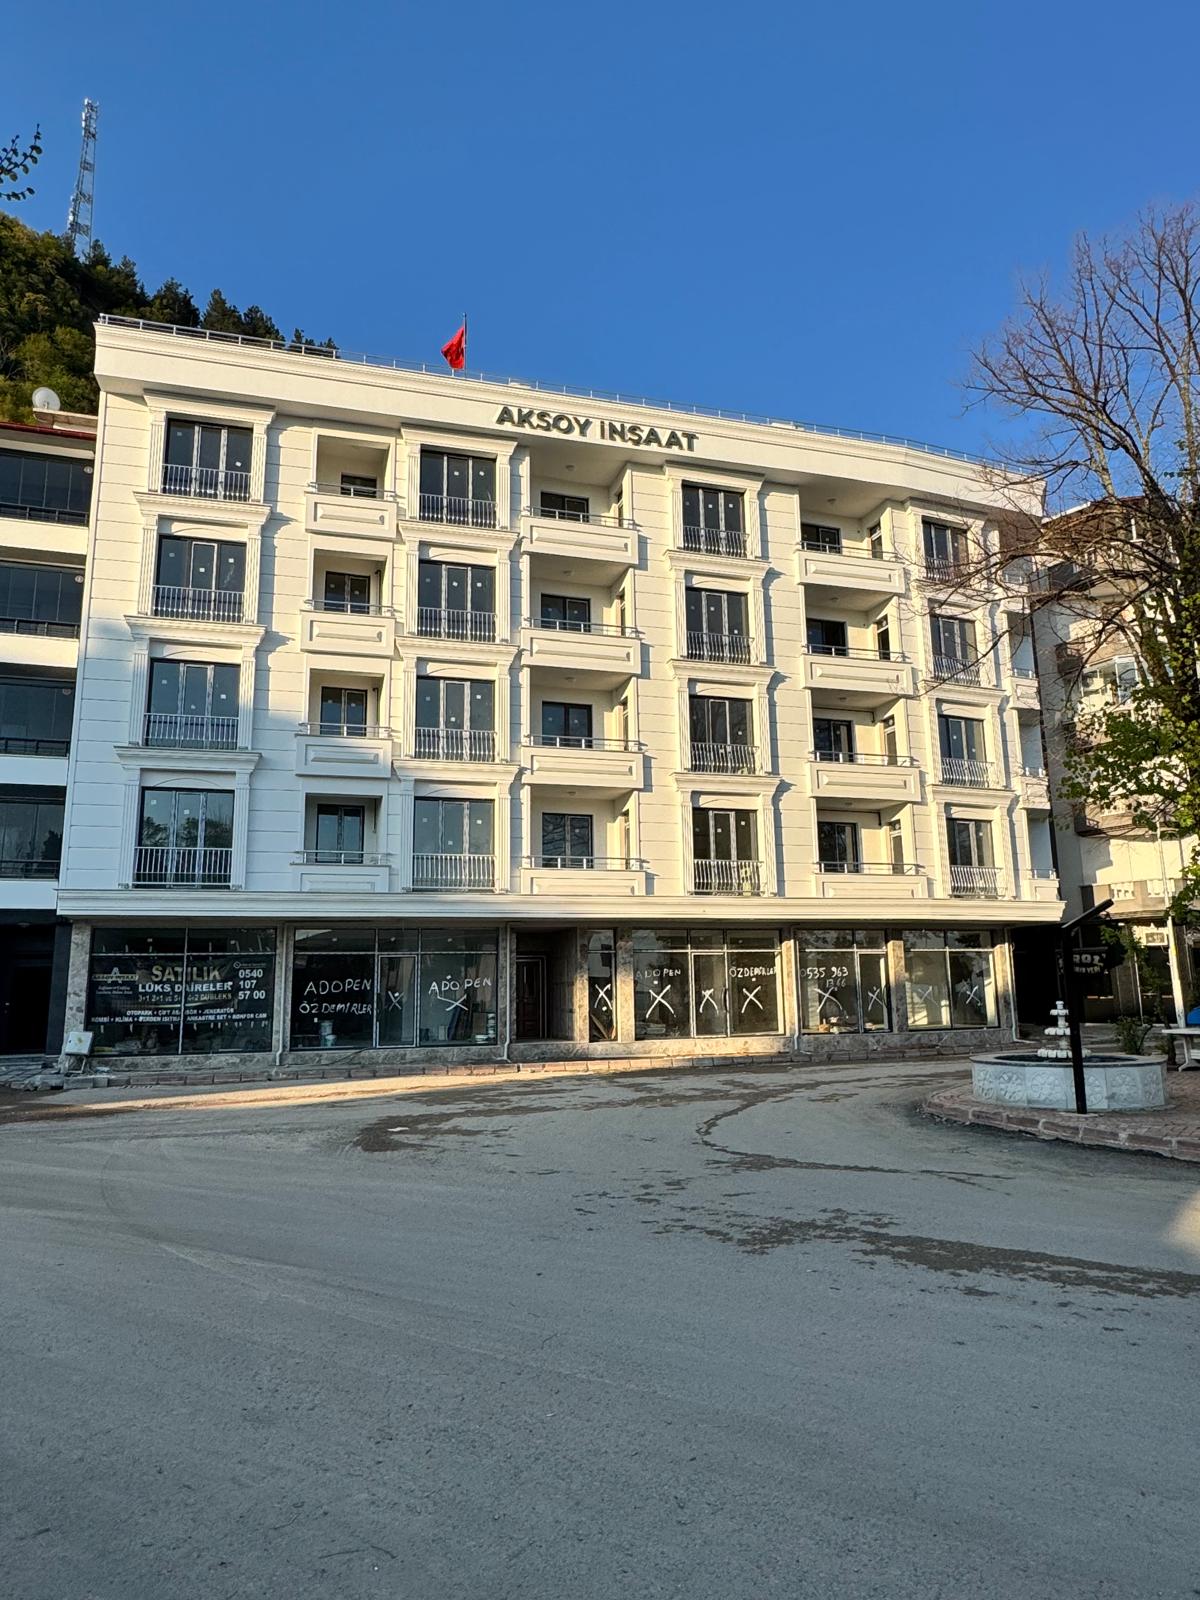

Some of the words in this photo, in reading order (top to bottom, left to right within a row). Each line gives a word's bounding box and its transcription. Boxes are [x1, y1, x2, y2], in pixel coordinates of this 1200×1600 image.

[495, 406, 593, 437] AKSOY
[600, 420, 699, 452] İNŞAAT
[151, 965, 221, 982] SATILIK
[238, 969, 263, 978] 0540
[831, 966, 849, 978] 963
[138, 982, 171, 993] LÜKS
[239, 980, 256, 989] 107
[303, 978, 372, 996] ADOPEN
[238, 990, 250, 1000] 57
[253, 990, 266, 1000] 00
